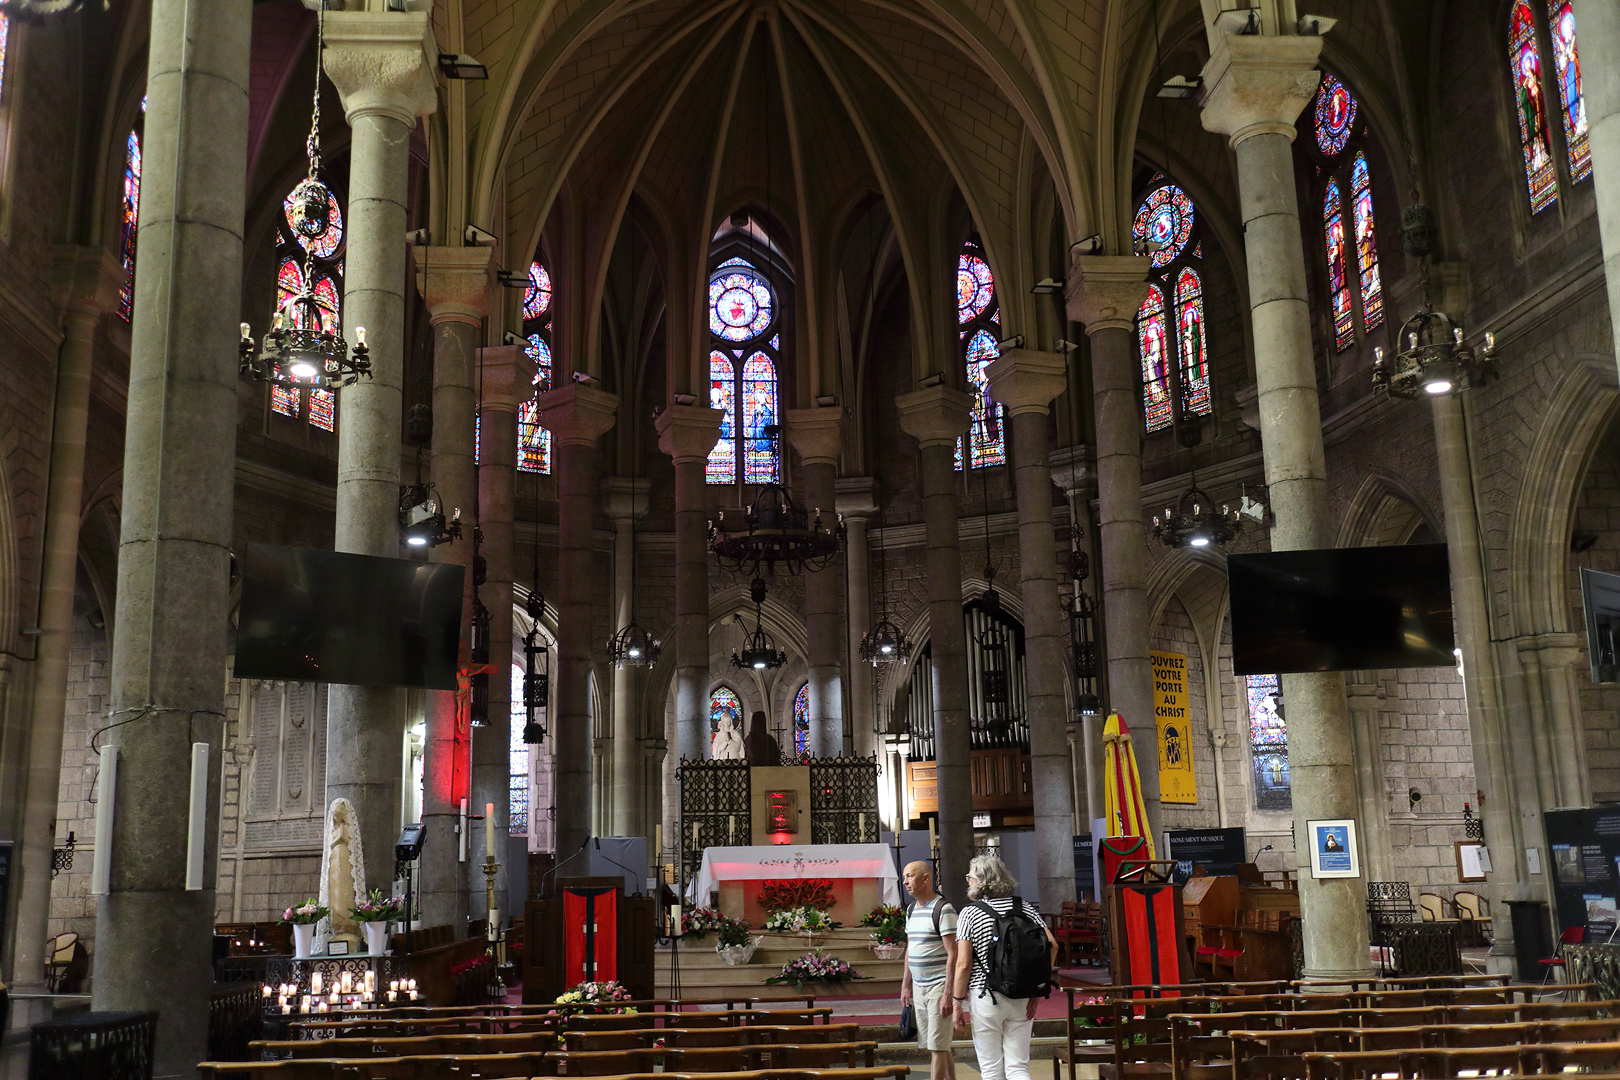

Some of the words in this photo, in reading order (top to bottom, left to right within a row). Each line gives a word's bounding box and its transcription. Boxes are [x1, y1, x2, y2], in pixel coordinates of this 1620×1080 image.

[1151, 656, 1184, 668] OUVREZ
[1154, 669, 1182, 681] VOTRE
[1156, 681, 1183, 693] PORTE
[1164, 695, 1176, 705] AU
[1155, 706, 1185, 718] CHRIST
[1170, 836, 1200, 844] MONUMENT
[1200, 835, 1225, 843] MUSIQUE
